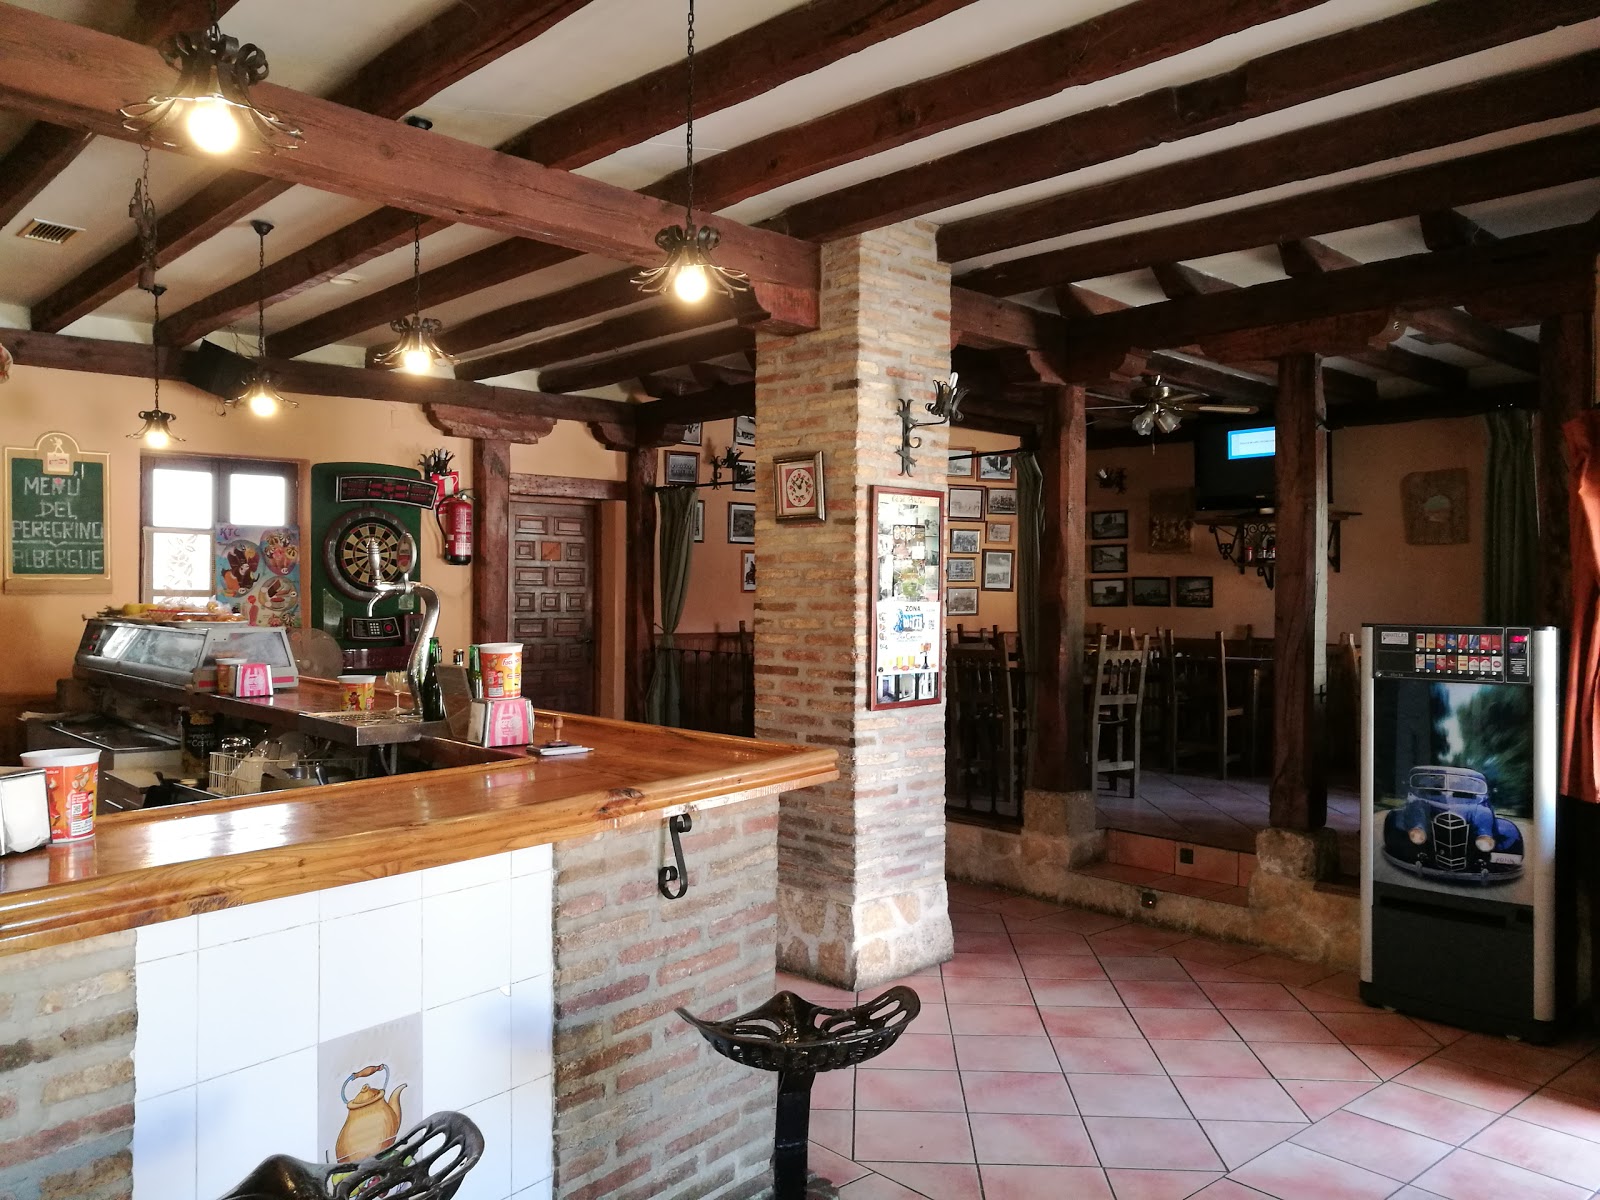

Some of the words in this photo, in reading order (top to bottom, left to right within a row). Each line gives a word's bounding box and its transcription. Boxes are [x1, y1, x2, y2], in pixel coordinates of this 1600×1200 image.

[24, 472, 80, 496] MENÚ
[35, 501, 78, 519] DEL
[12, 521, 103, 540] PEREGRINO
[13, 549, 103, 569] ALBERGUE
